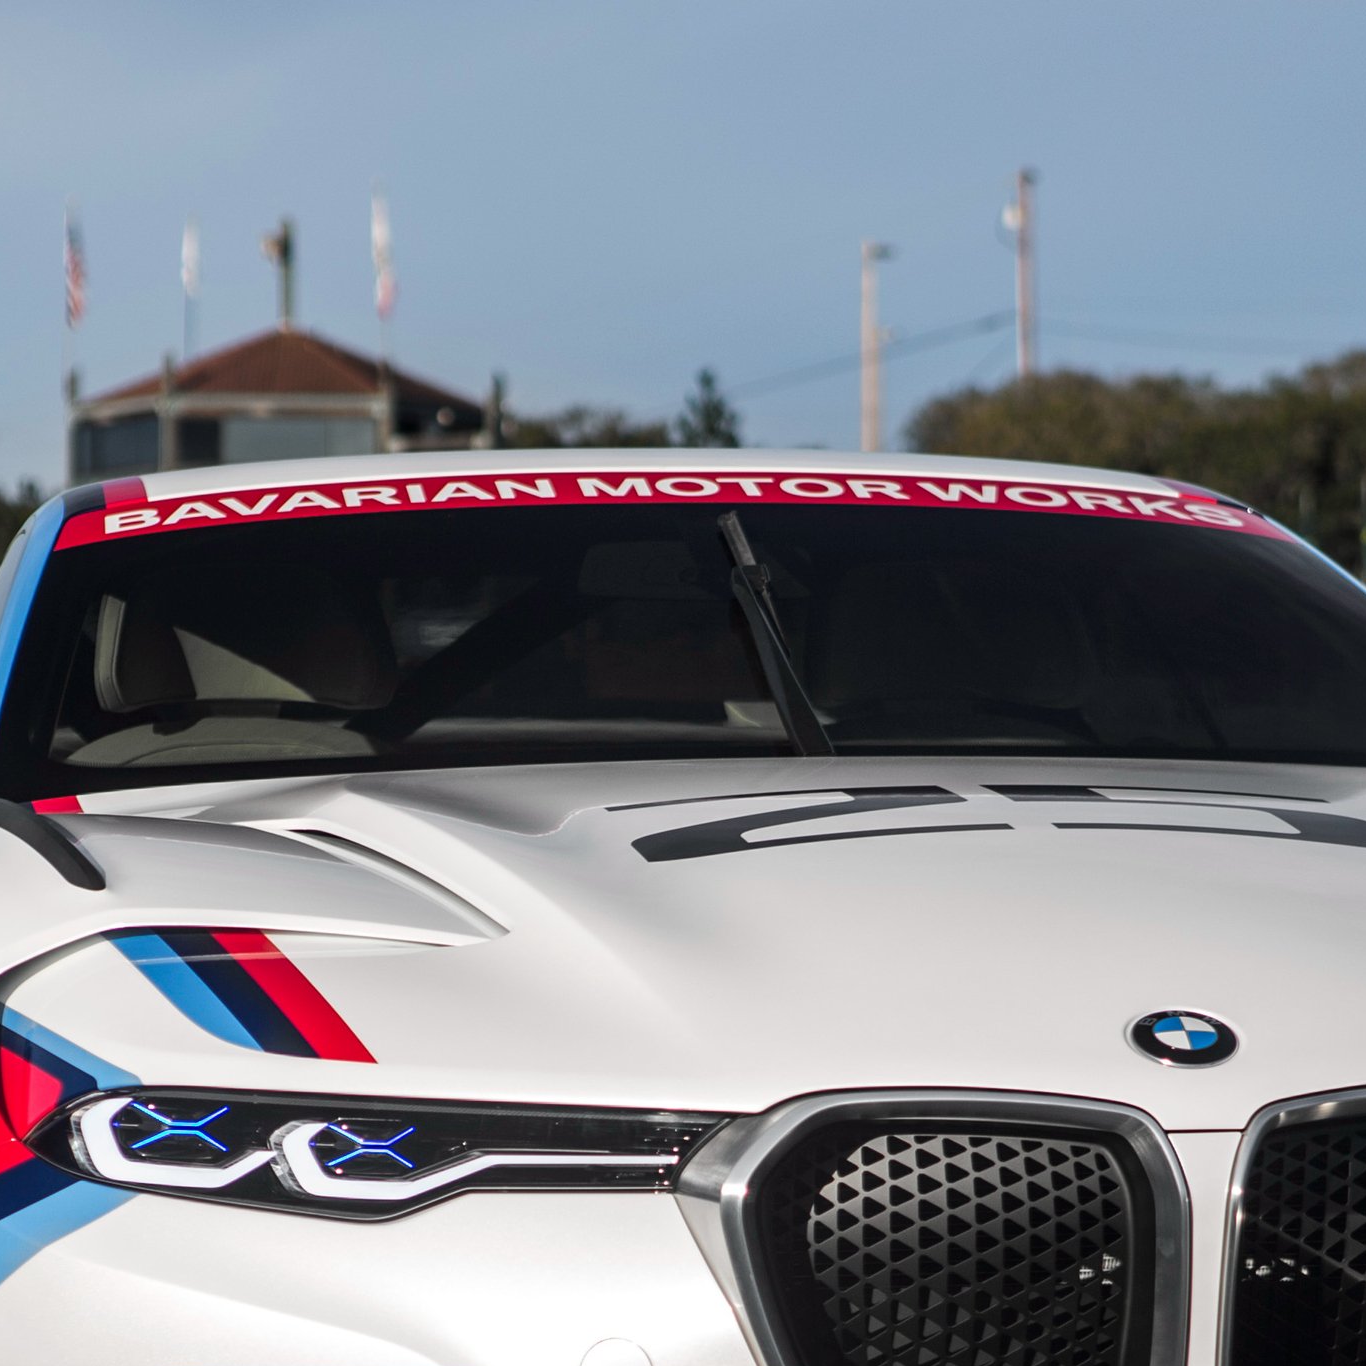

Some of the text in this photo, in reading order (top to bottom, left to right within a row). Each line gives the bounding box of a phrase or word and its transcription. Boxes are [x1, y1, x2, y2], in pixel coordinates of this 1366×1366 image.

[104, 477, 1244, 535] BAVARIAN MOTOR WORKS
[1138, 1010, 1221, 1026] BMW
